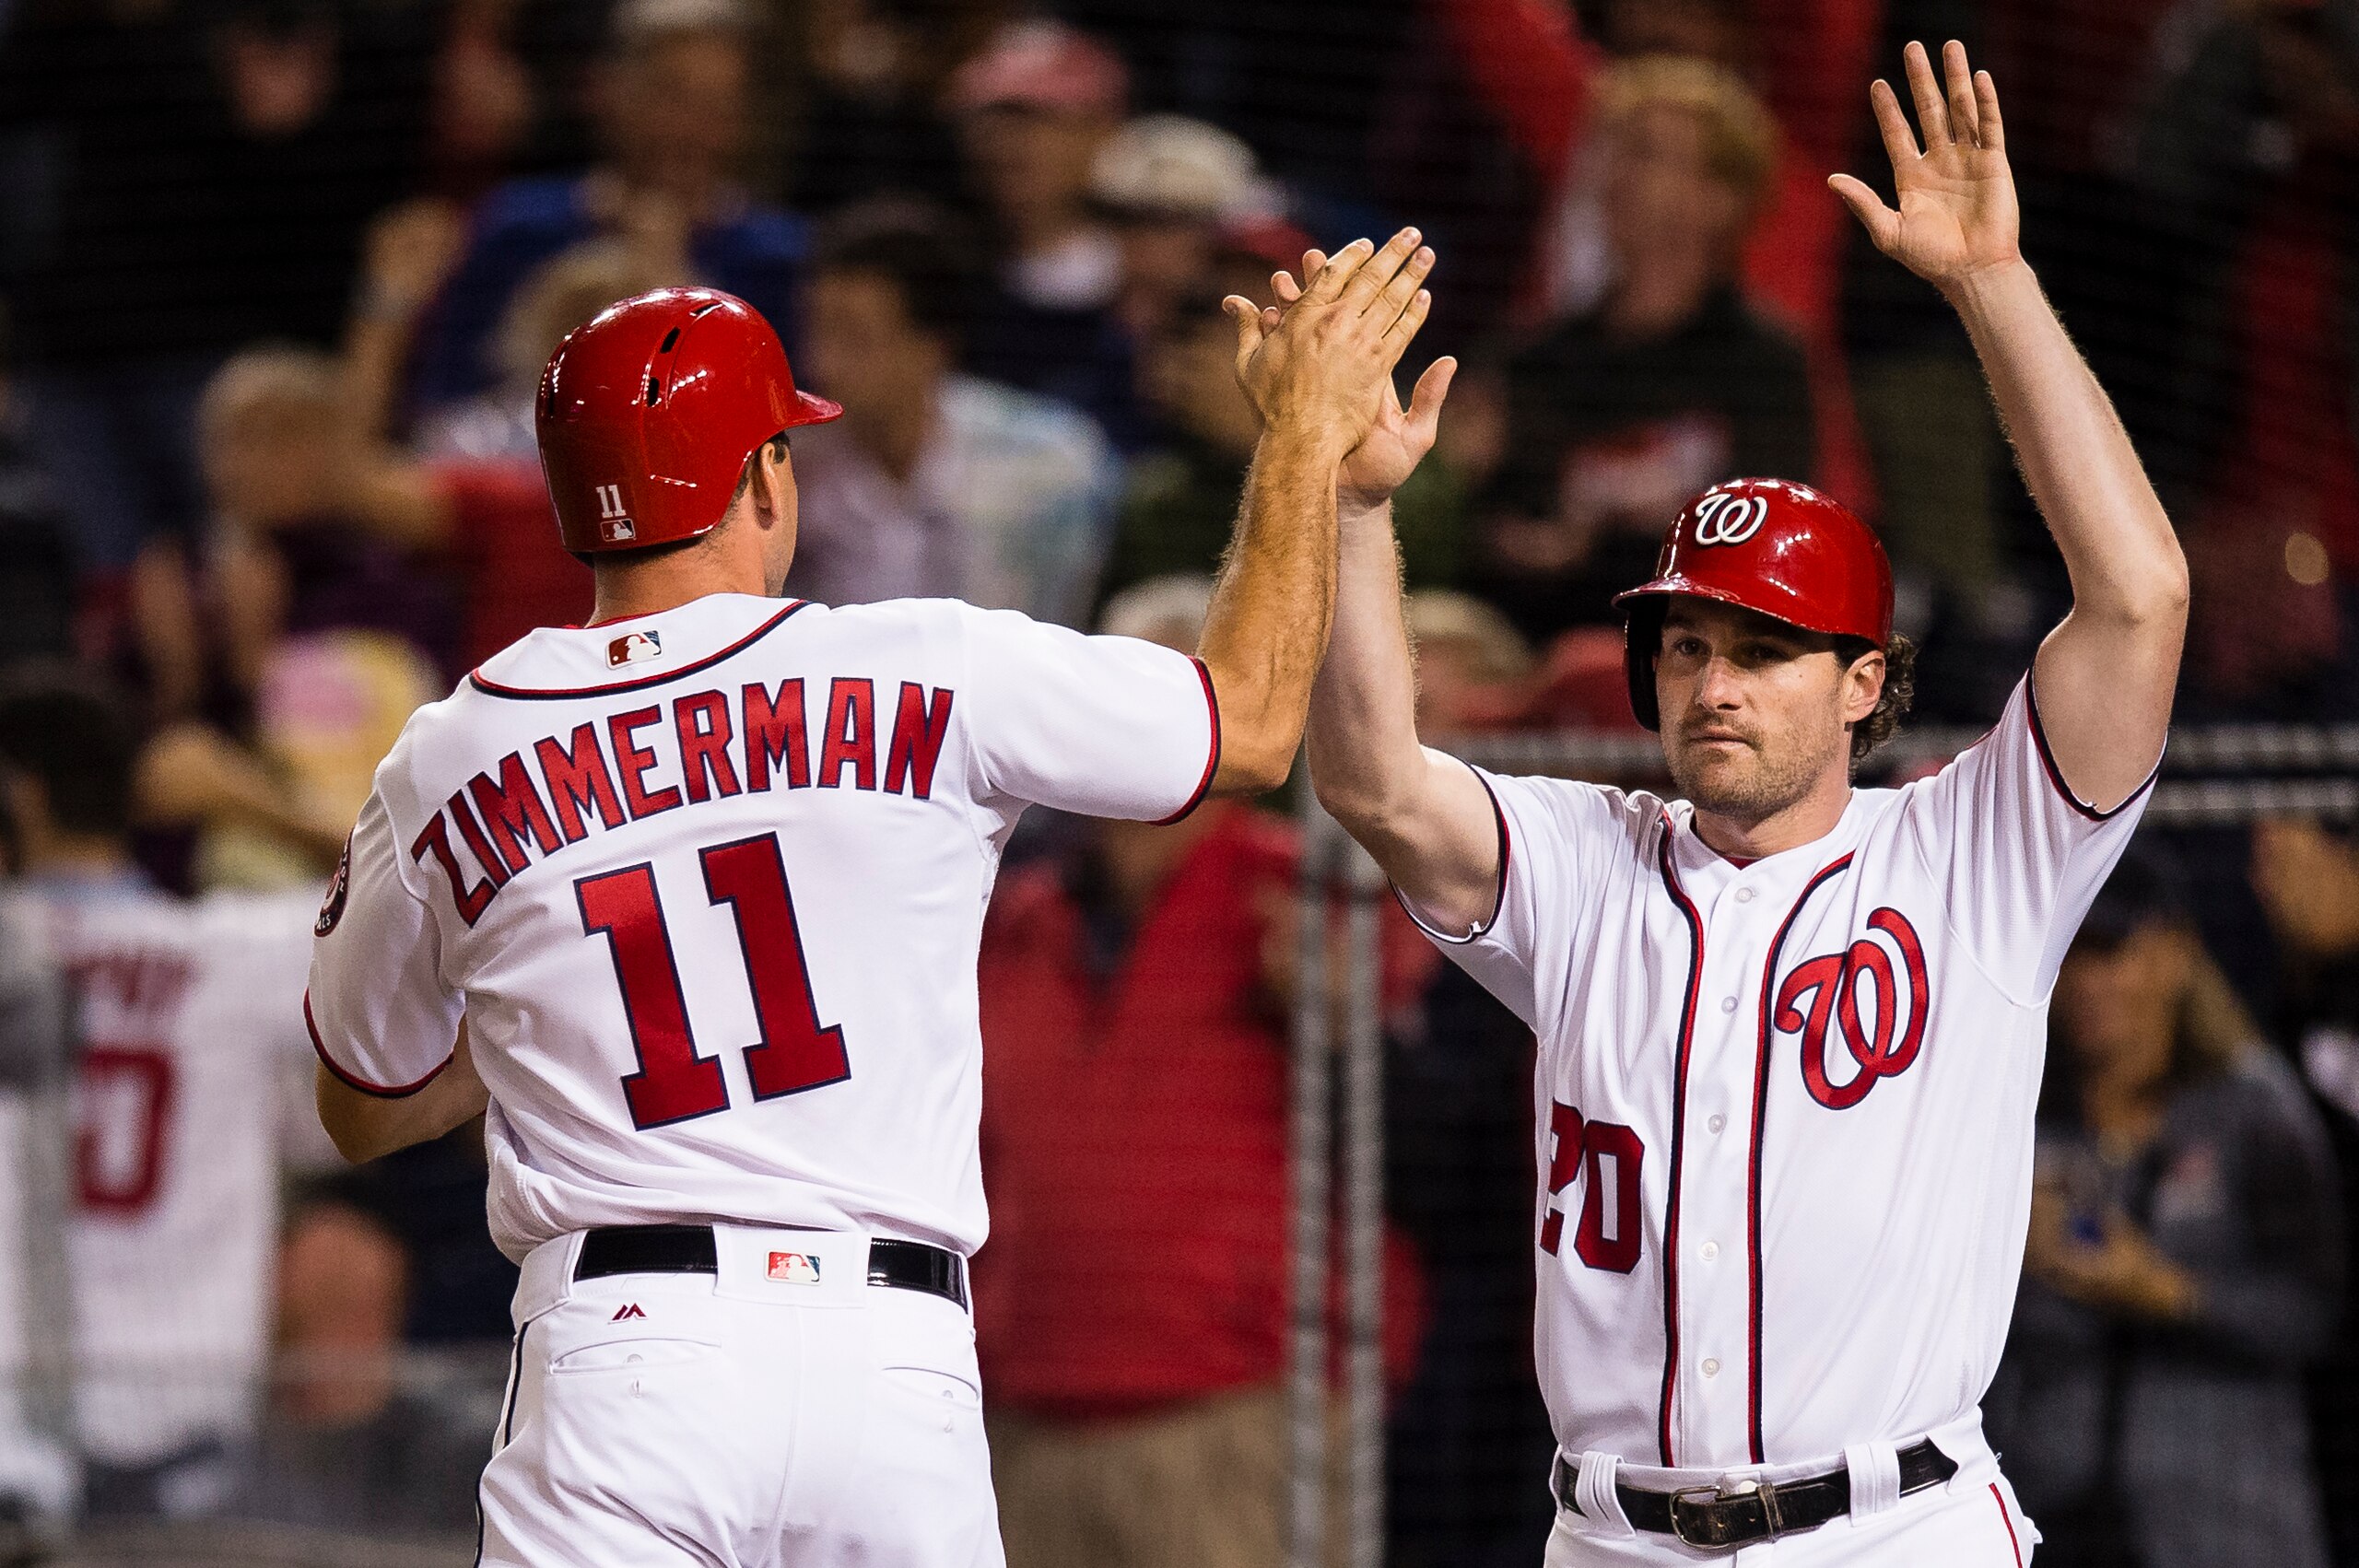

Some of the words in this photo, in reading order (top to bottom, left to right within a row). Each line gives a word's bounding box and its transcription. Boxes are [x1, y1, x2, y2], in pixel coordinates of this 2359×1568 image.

[596, 485, 627, 518] 11
[1695, 493, 1768, 546] W
[411, 677, 954, 929] ZIMMERMAN
[573, 831, 851, 1132] 11
[1773, 907, 1930, 1111] W
